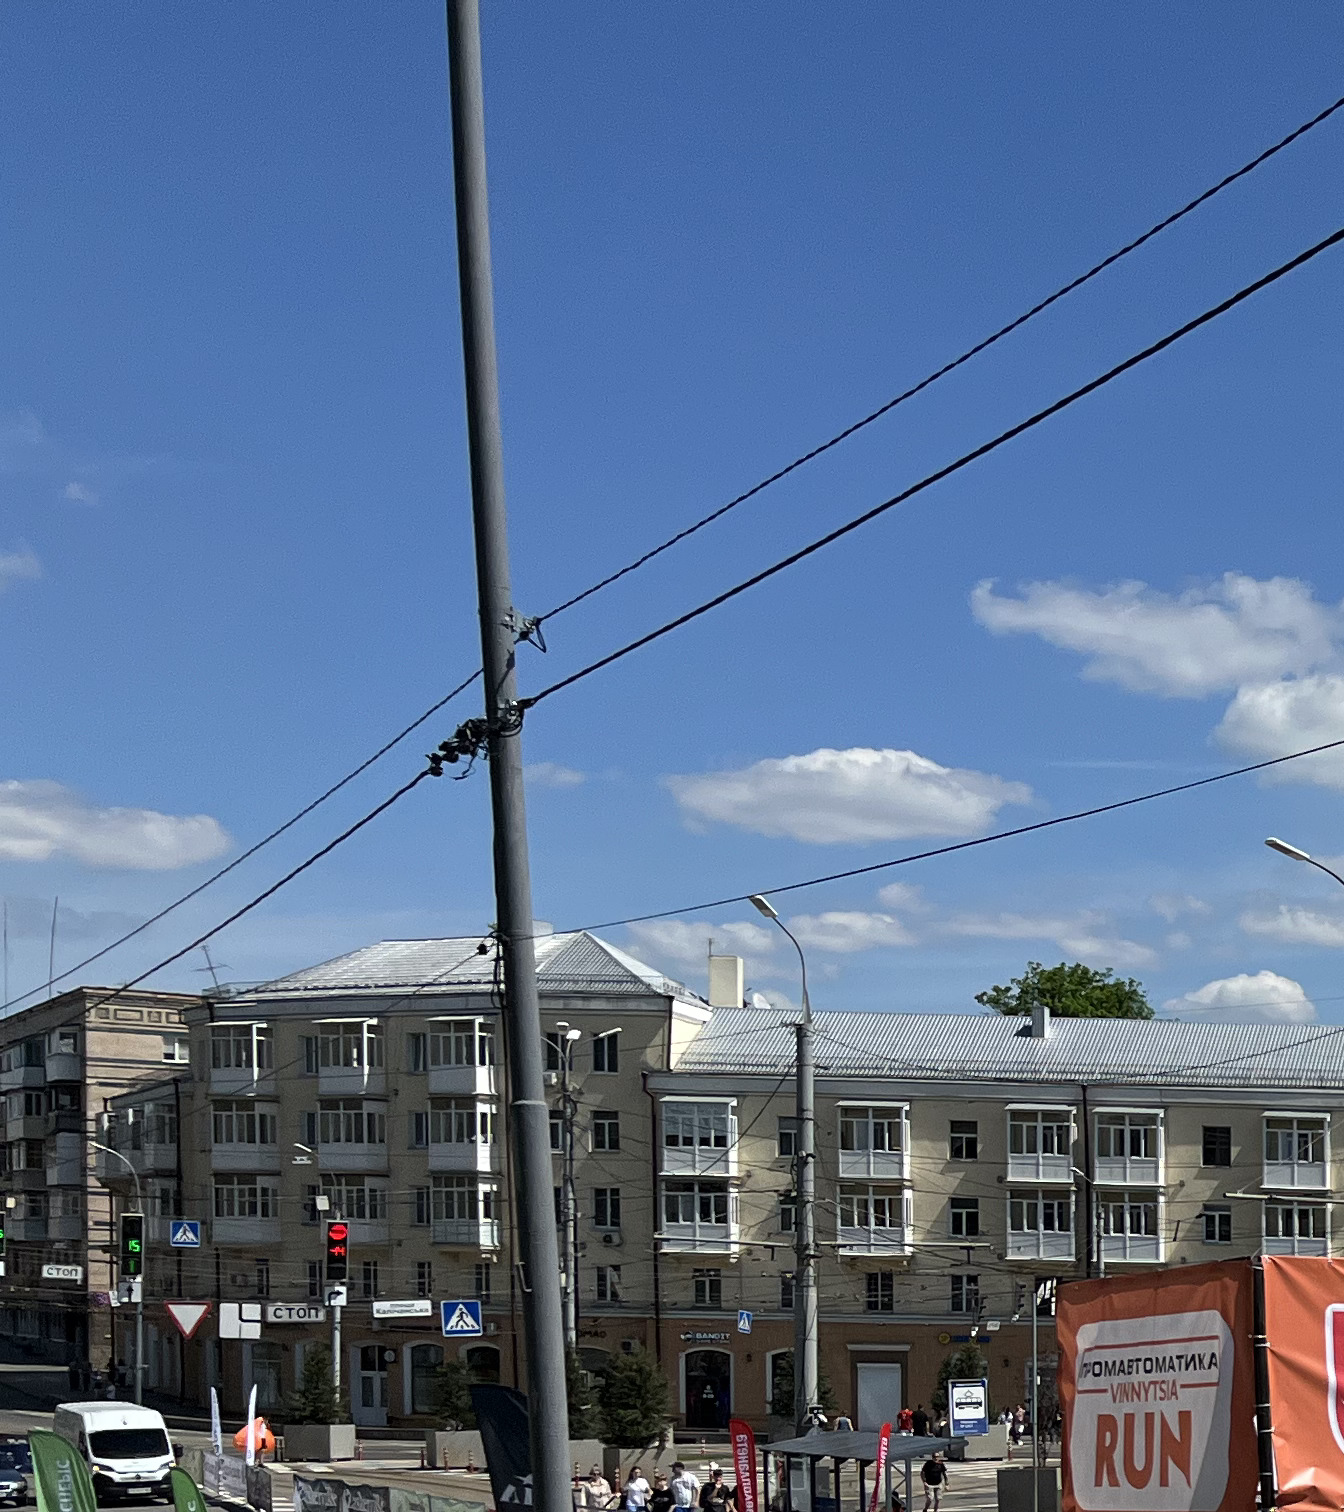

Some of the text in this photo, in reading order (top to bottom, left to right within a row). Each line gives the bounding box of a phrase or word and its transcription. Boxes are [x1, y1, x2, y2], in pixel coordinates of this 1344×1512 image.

[46, 1267, 78, 1277] СТОП
[273, 1307, 319, 1319] СТОП
[1110, 1379, 1179, 1404] VINNYTSIA
[1094, 1410, 1193, 1490] RUN
